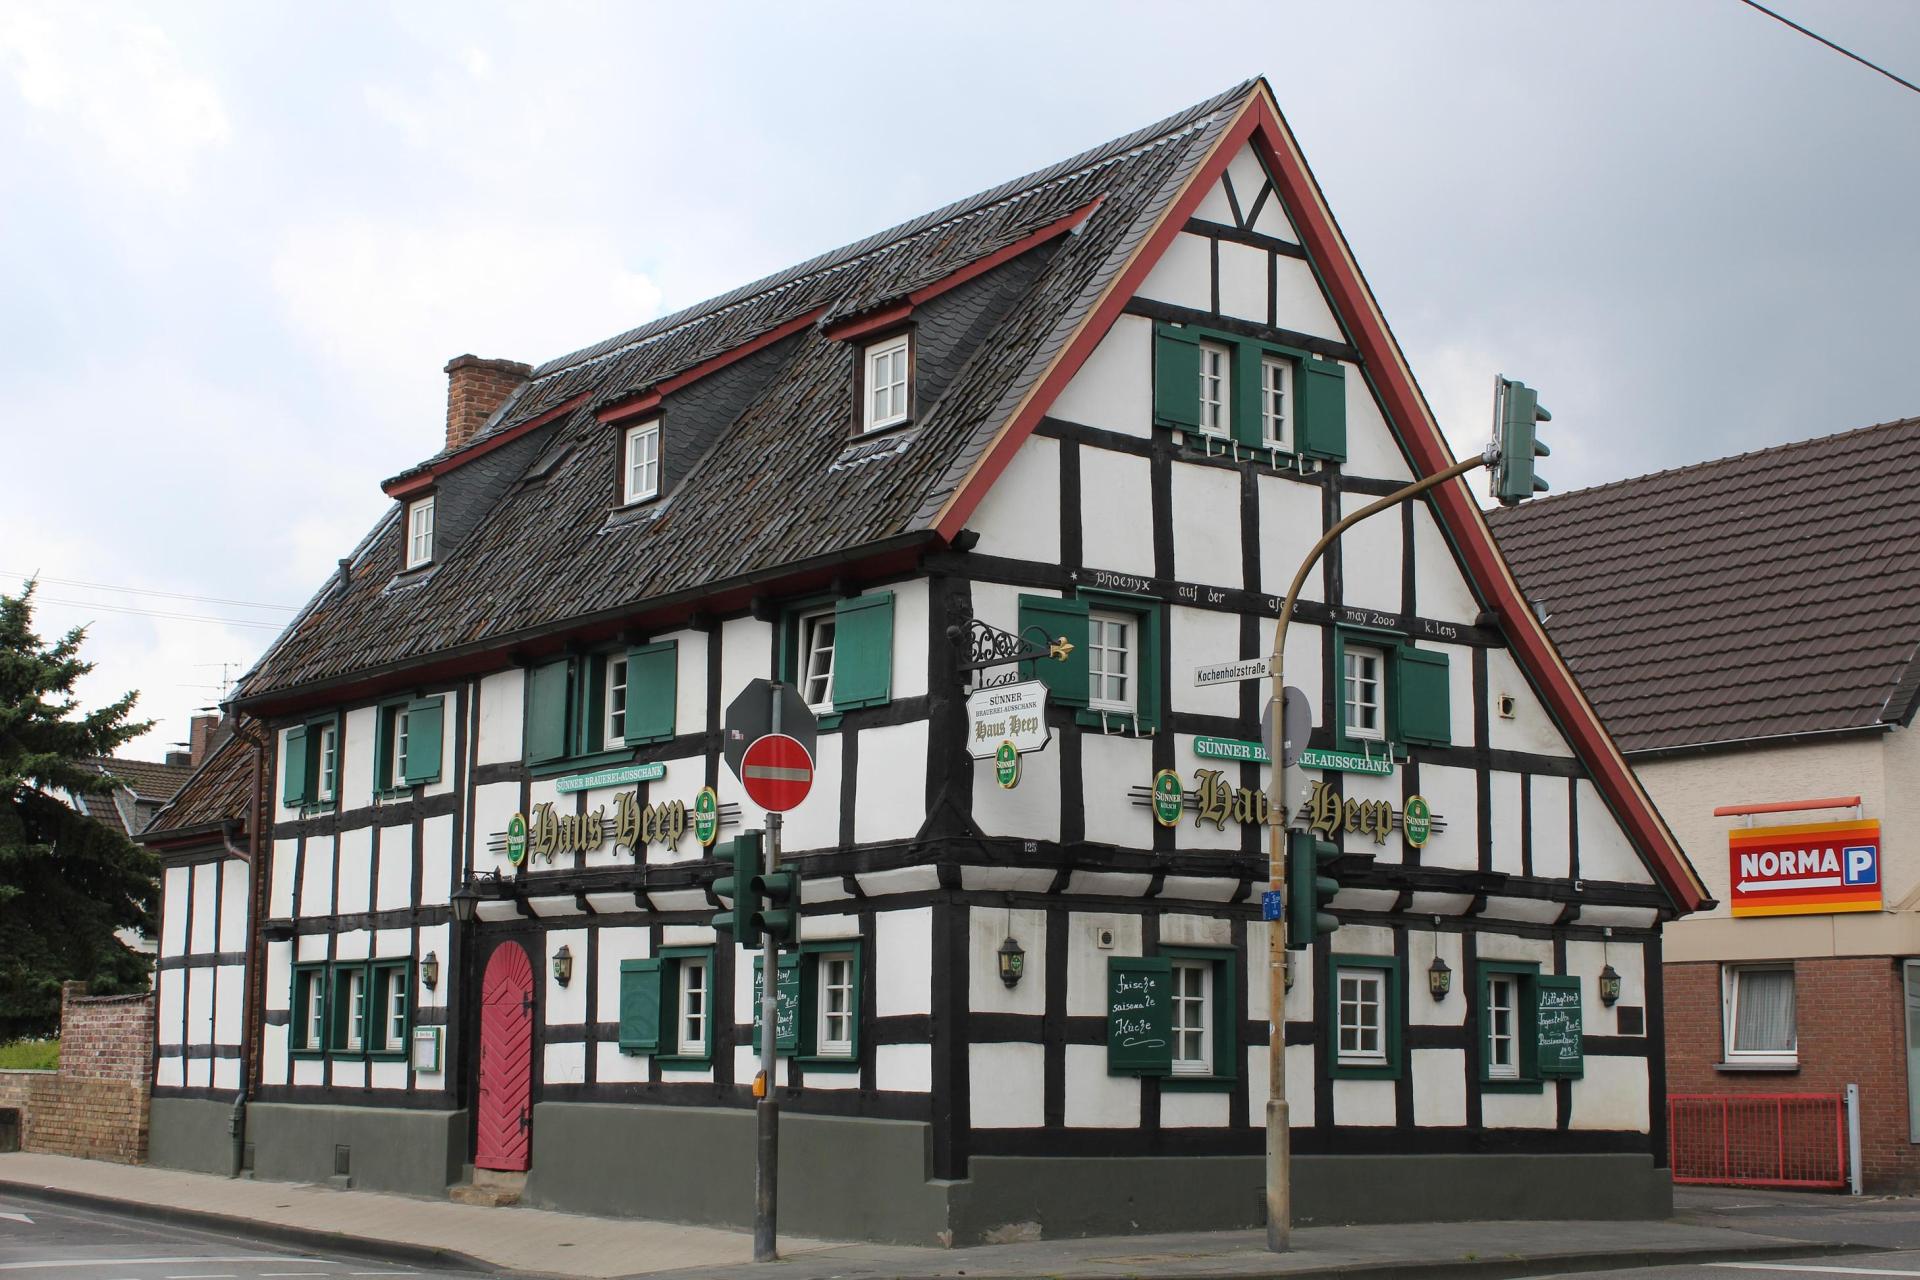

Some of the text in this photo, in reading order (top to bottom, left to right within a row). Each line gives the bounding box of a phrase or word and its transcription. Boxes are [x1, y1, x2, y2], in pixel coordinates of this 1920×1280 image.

[1207, 587, 1225, 603] der
[1346, 609, 1395, 627] may 2000
[1197, 662, 1266, 682] Kochenholzstraße
[975, 714, 1039, 743] Haus Heep
[1197, 738, 1251, 758] SÜNNER
[1303, 779, 1394, 846] Heep
[531, 790, 686, 864] Haus Heep
[1740, 848, 1873, 881] NORMA P
